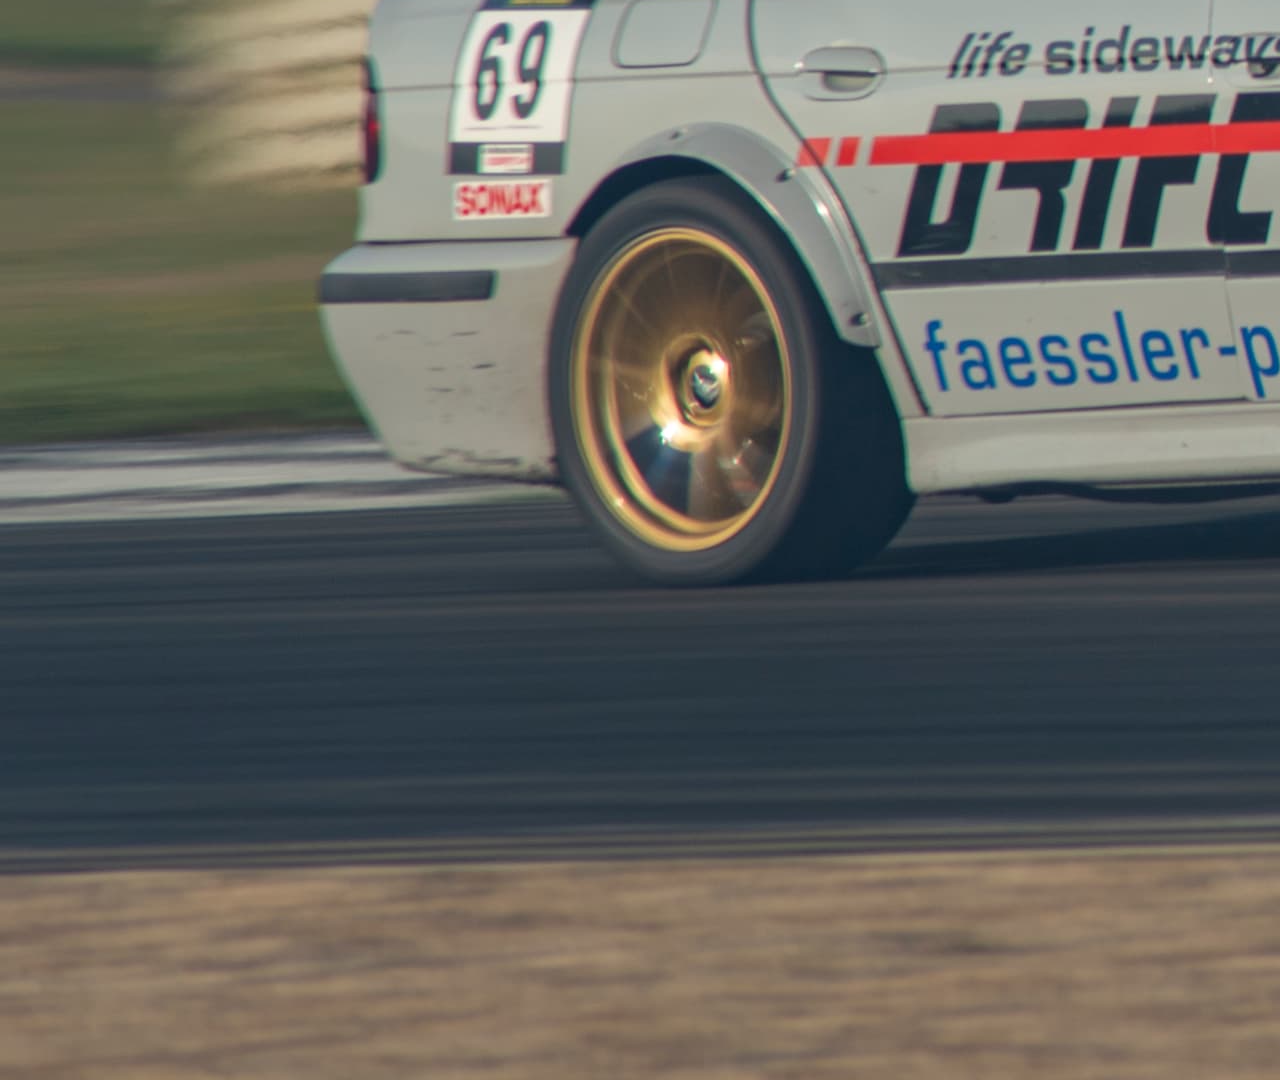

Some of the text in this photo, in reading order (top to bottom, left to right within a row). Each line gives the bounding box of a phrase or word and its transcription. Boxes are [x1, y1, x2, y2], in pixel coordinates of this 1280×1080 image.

[472, 20, 551, 120] 69
[948, 31, 1032, 79] life
[456, 183, 545, 217] SONAX
